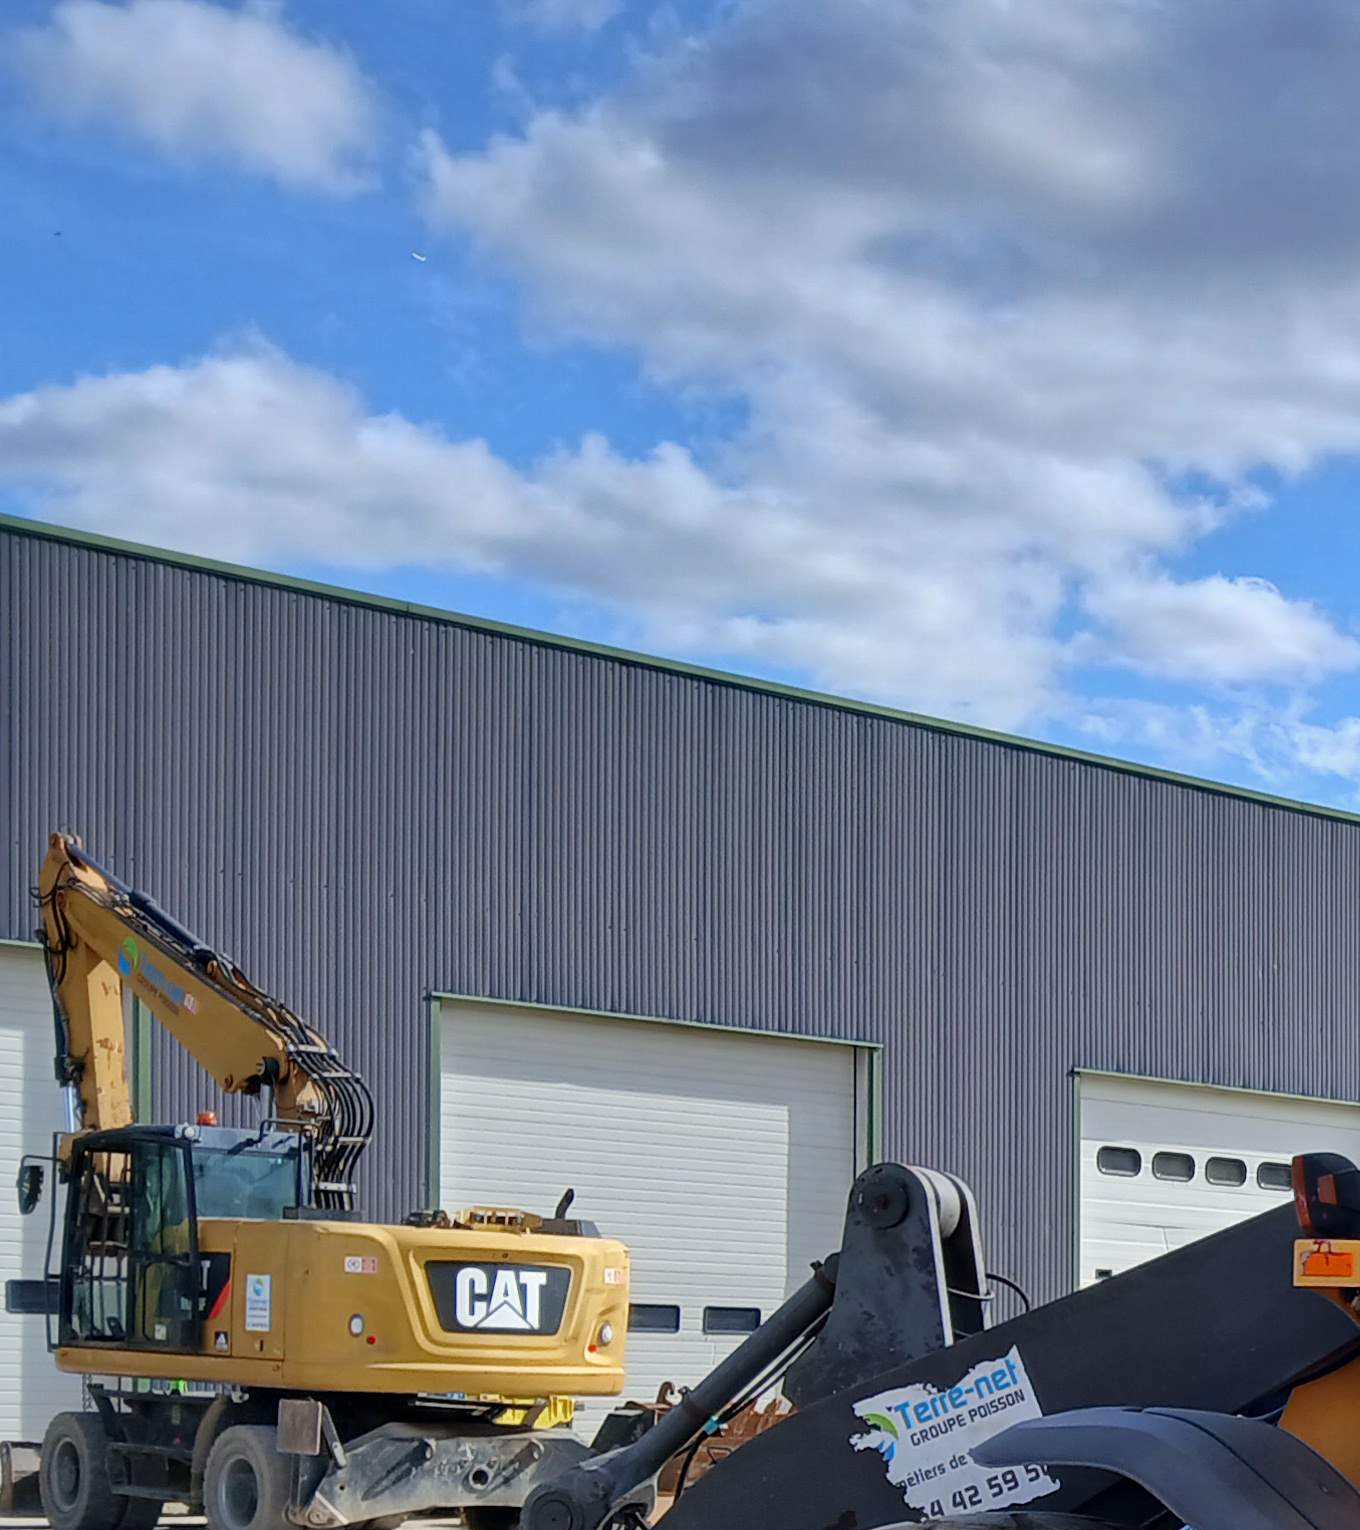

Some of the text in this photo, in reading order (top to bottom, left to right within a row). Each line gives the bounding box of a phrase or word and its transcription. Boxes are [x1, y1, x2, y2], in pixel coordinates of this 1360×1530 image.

[456, 1267, 547, 1330] CAT
[894, 1357, 1019, 1429] Terre-net
[910, 1389, 1025, 1446] GROUPE POISSON
[952, 1485, 982, 1510] 42
[986, 1470, 1019, 1498] 59
